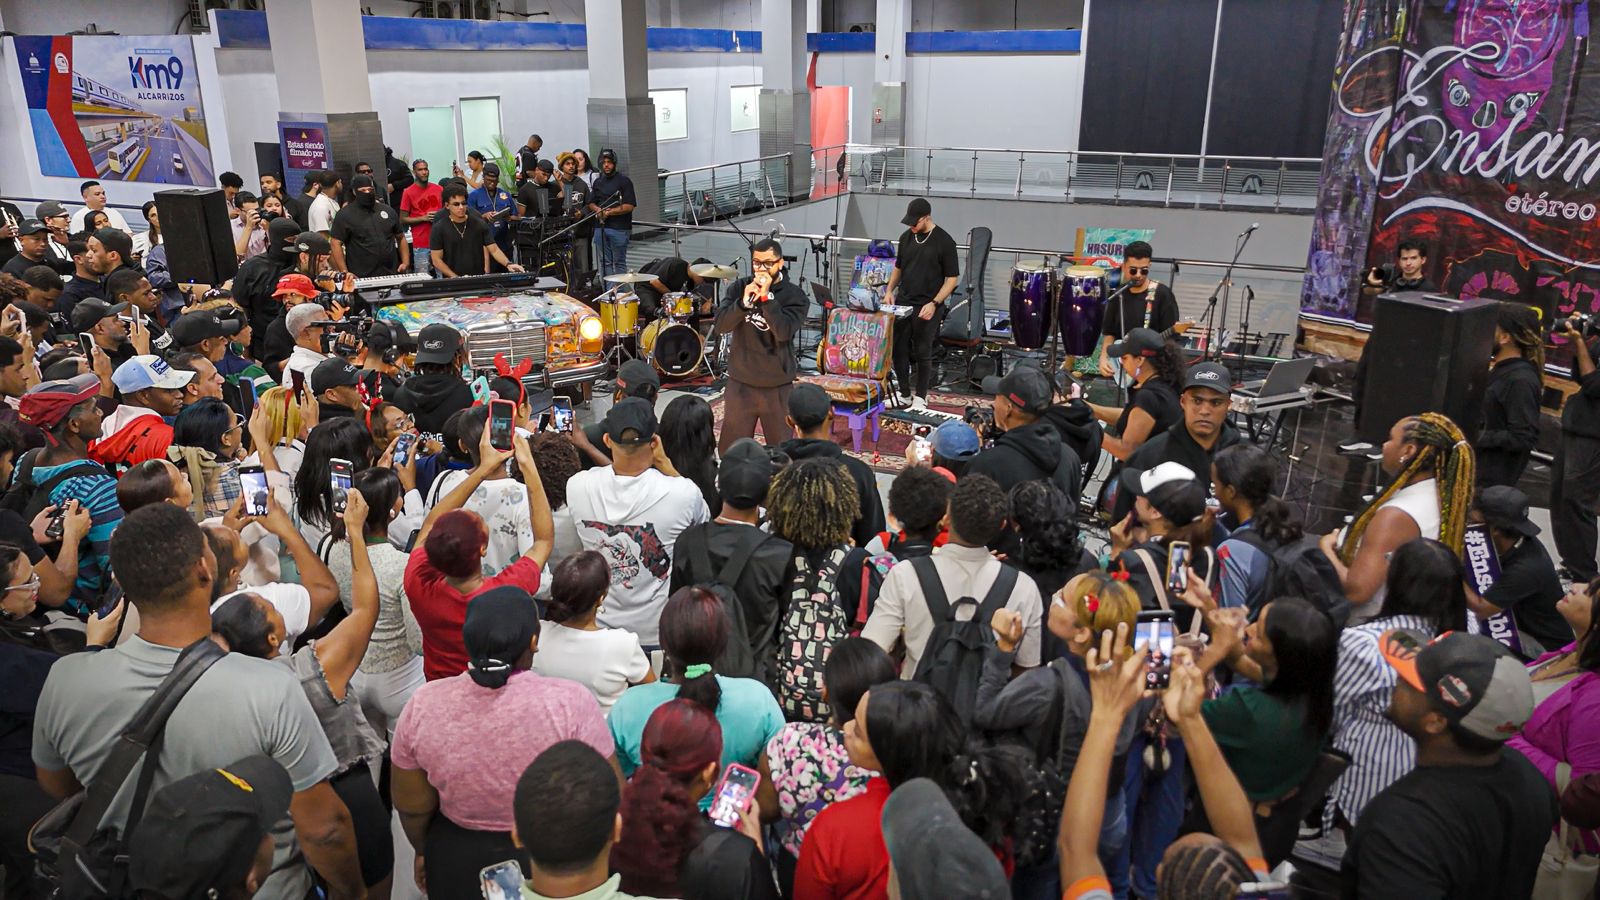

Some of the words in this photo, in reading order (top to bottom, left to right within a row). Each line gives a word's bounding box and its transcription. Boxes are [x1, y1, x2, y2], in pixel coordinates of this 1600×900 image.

[128, 56, 183, 89] Km9
[137, 92, 185, 101] ALCARRIZOS
[287, 140, 304, 148] Estas
[289, 148, 312, 156] filmado
[1505, 192, 1596, 221] etéreo
